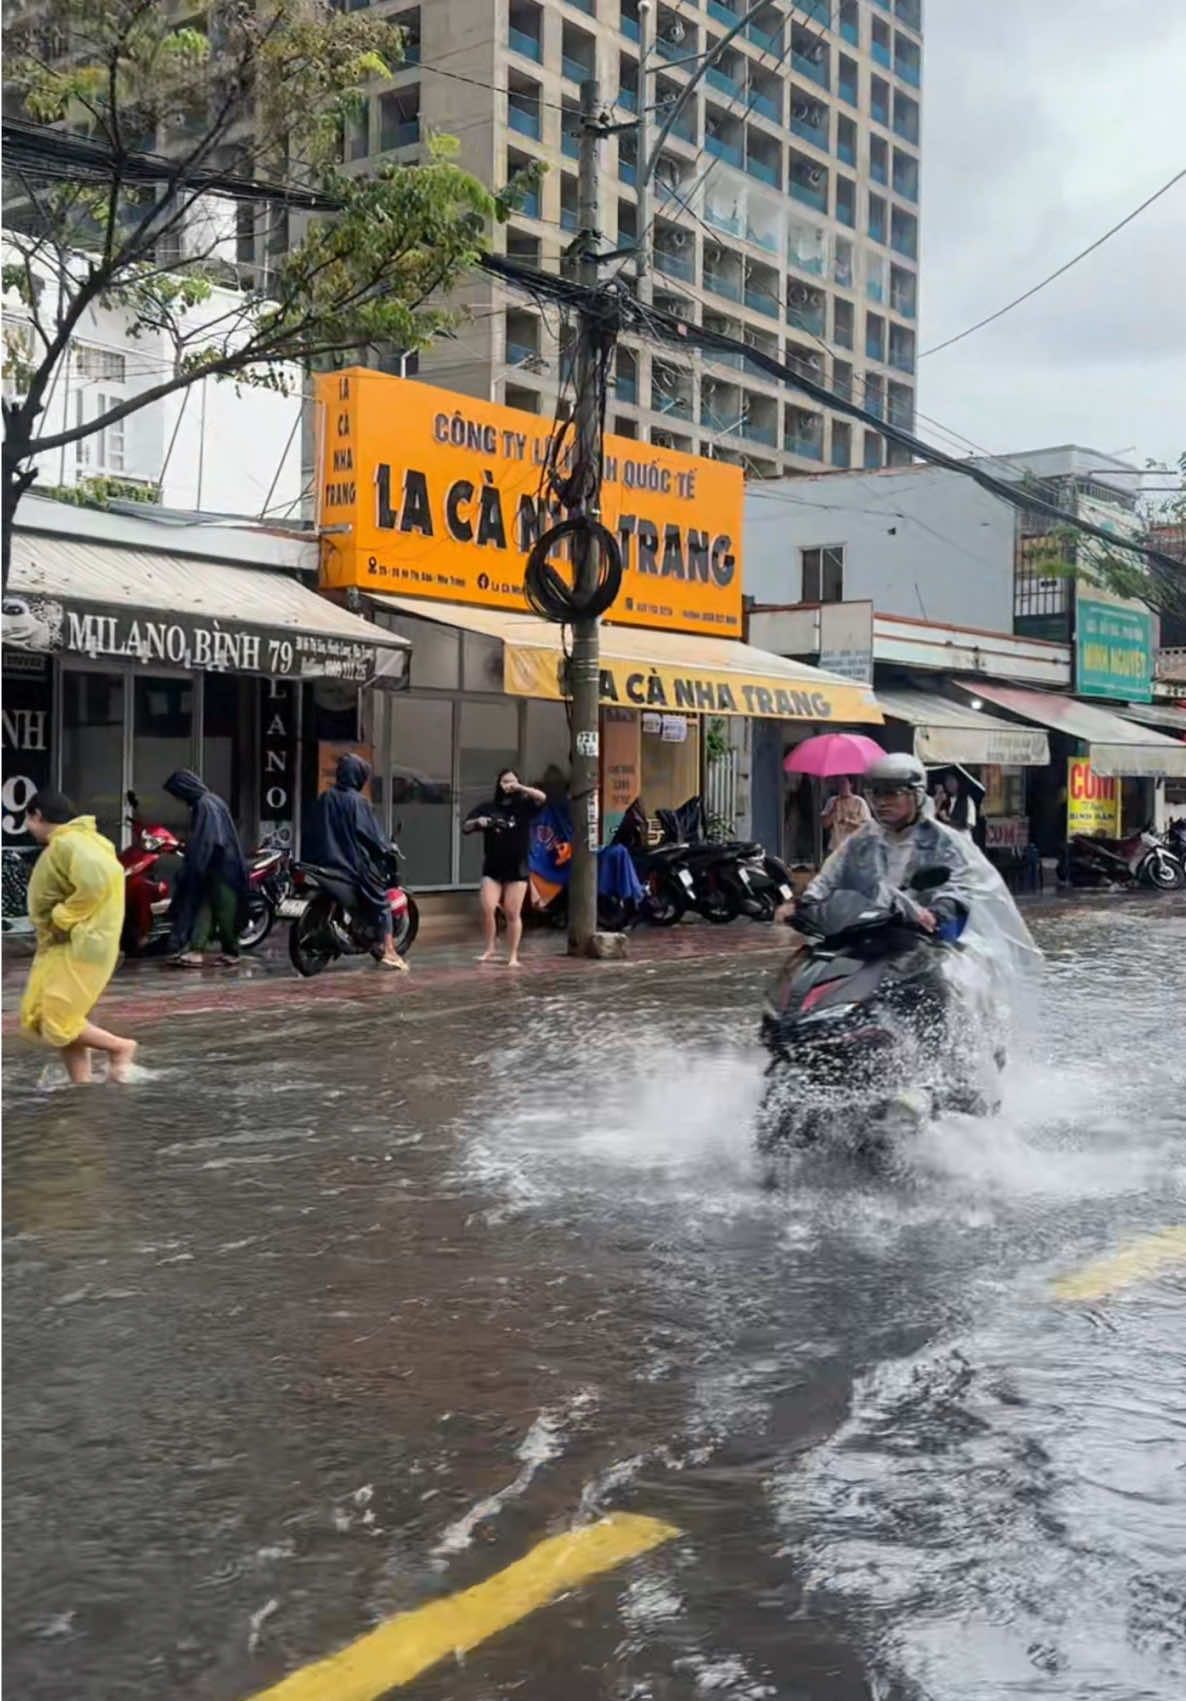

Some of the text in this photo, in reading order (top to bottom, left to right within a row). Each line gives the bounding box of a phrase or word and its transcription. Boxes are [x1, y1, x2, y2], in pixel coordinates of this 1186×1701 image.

[338, 377, 349, 401] LA
[337, 408, 349, 437] CÀ
[434, 411, 497, 454] CÔNG
[503, 430, 528, 461] TY
[333, 448, 353, 472] NHA
[622, 457, 671, 494] QUỐC
[676, 468, 699, 500] TẾ
[325, 482, 356, 507] TRANG
[374, 463, 434, 536] LA
[445, 470, 508, 550] CÀ
[616, 514, 735, 587] TRANG
[66, 611, 294, 675] MILANO BÌNH 79
[625, 667, 668, 706] CÀ
[673, 678, 739, 712] NHA
[741, 685, 832, 718] TRANG
